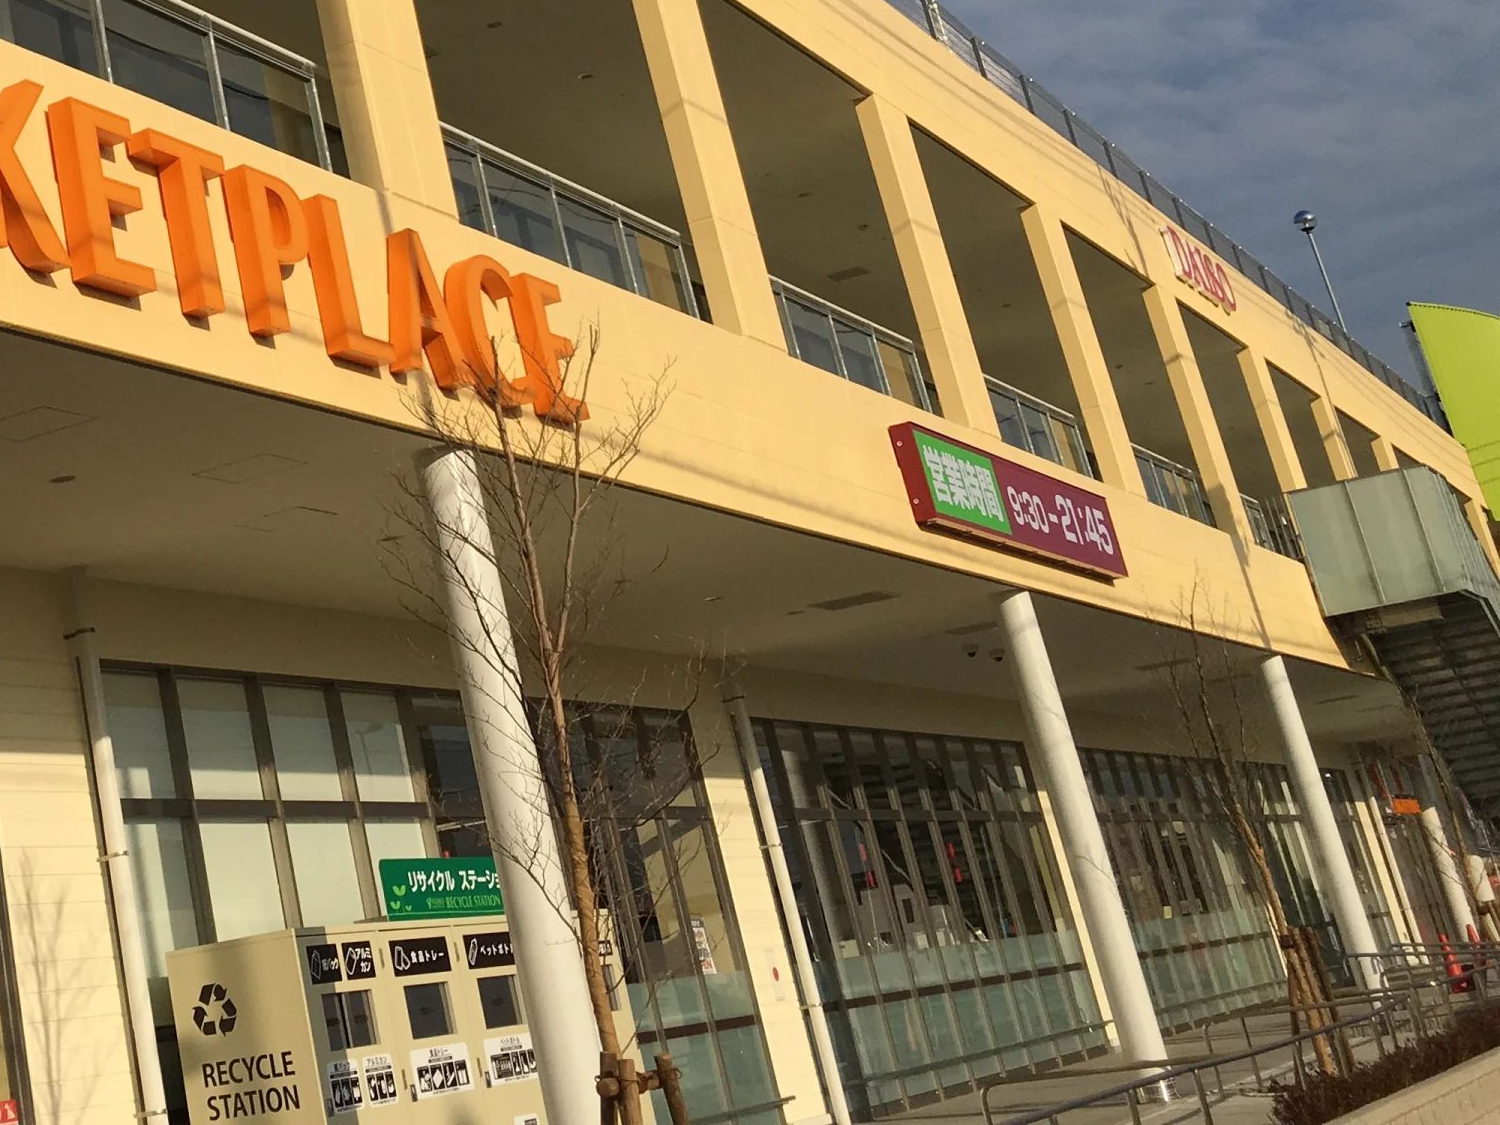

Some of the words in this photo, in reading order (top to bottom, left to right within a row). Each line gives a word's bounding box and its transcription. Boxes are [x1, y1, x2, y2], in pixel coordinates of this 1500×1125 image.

[1162, 225, 1237, 313] DAISO
[922, 444, 1005, 523] 営業時間
[407, 870, 455, 893] リサイクル
[445, 896, 474, 909] RECYCLE
[410, 950, 445, 964] 食品トレー
[201, 1050, 296, 1088] RECYCLE
[206, 1084, 301, 1121] STATION
